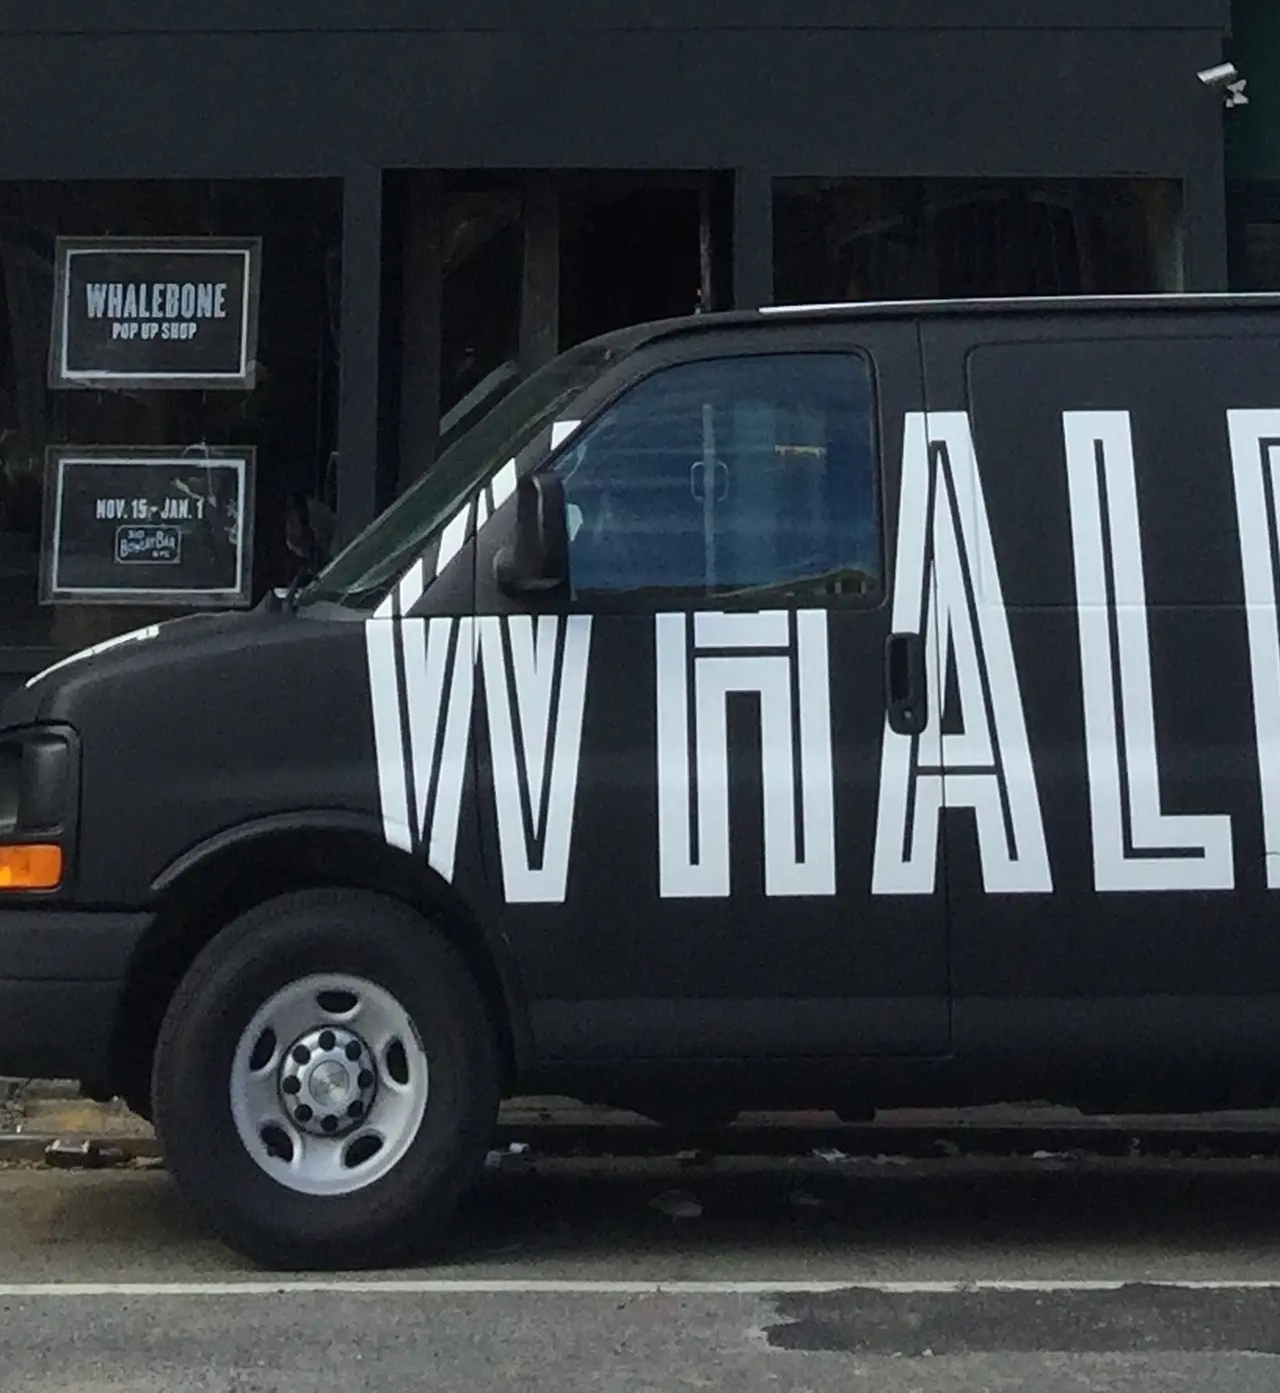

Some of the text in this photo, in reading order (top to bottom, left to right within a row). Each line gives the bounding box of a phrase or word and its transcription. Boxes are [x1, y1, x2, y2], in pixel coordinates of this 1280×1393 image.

[86, 282, 228, 319] WHALEBONE
[112, 322, 197, 340] POP UP SHOP
[96, 498, 128, 519] NOV.
[161, 497, 192, 519] JAN.
[196, 497, 204, 519] 1
